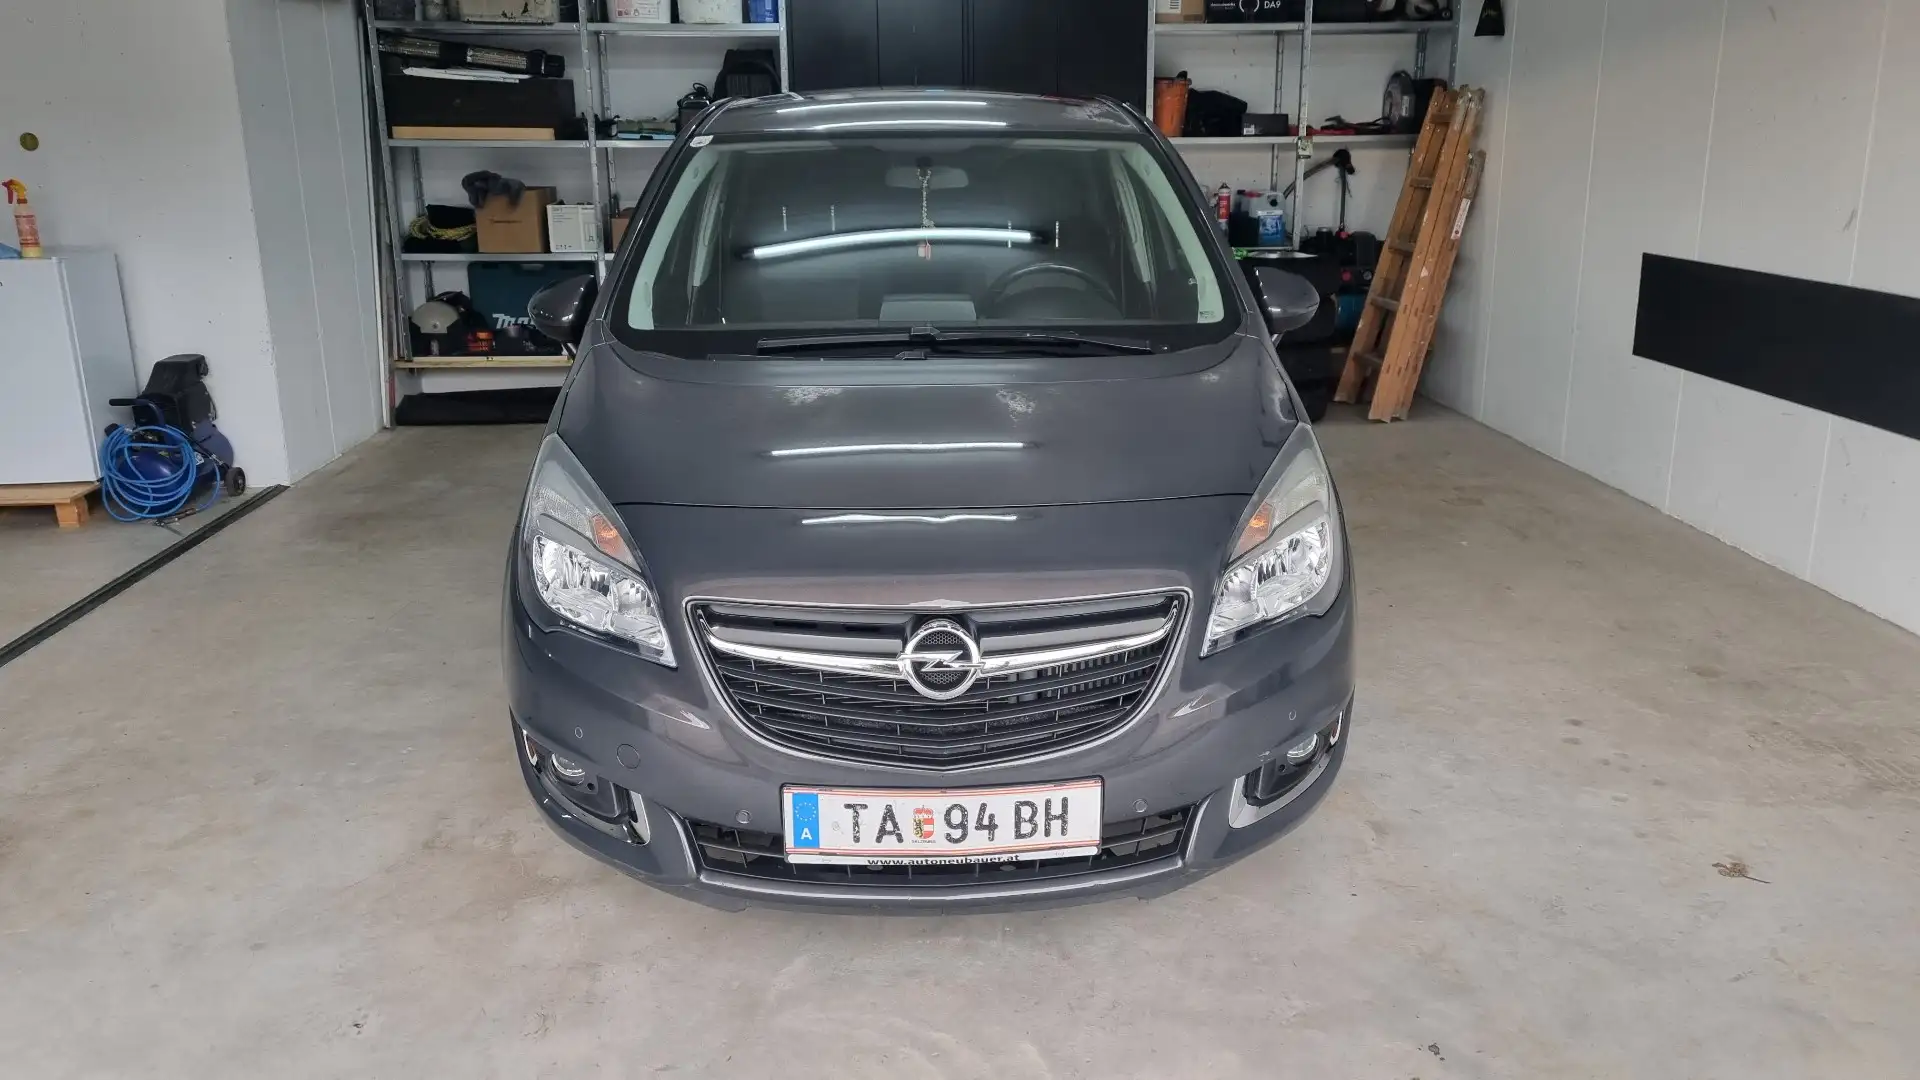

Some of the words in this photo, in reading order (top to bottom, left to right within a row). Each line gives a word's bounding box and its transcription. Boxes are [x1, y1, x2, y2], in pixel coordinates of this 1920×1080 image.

[1264, 0, 1281, 9] DA9
[492, 313, 535, 329] Ma
[843, 803, 904, 844] TA
[943, 802, 999, 844] 94
[1014, 796, 1069, 840] BH
[800, 827, 812, 840] A
[867, 854, 1020, 866] www.autoneubauer.at
